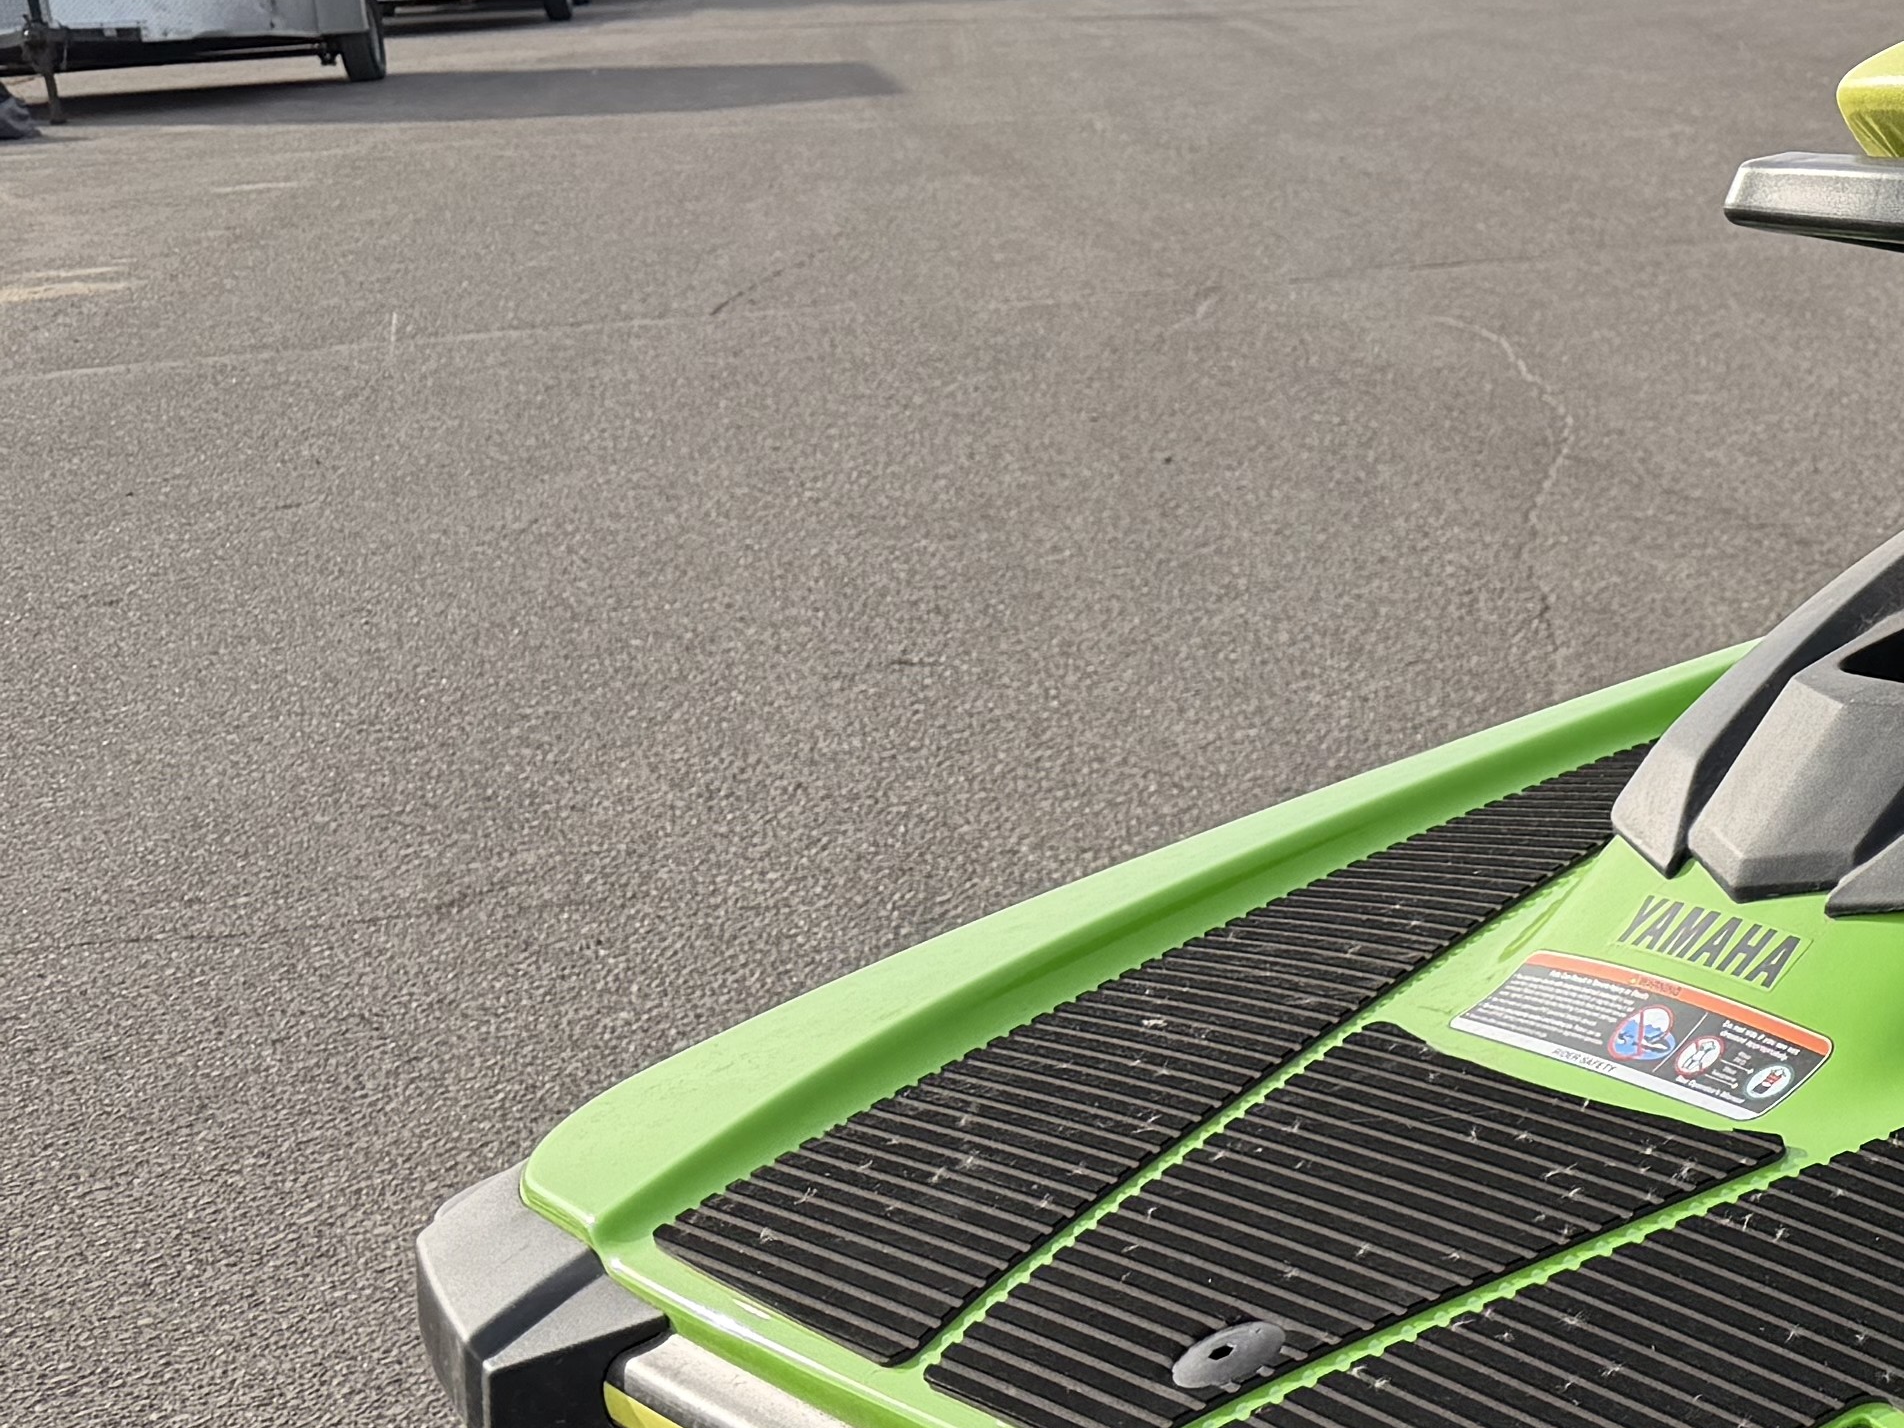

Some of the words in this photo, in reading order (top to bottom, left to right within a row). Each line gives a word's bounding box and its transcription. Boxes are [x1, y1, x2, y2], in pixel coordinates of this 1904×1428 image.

[1618, 895, 1801, 989] YAMAHA
[1551, 1047, 1581, 1067] RIDER
[1579, 1055, 1617, 1073] SAFETY
